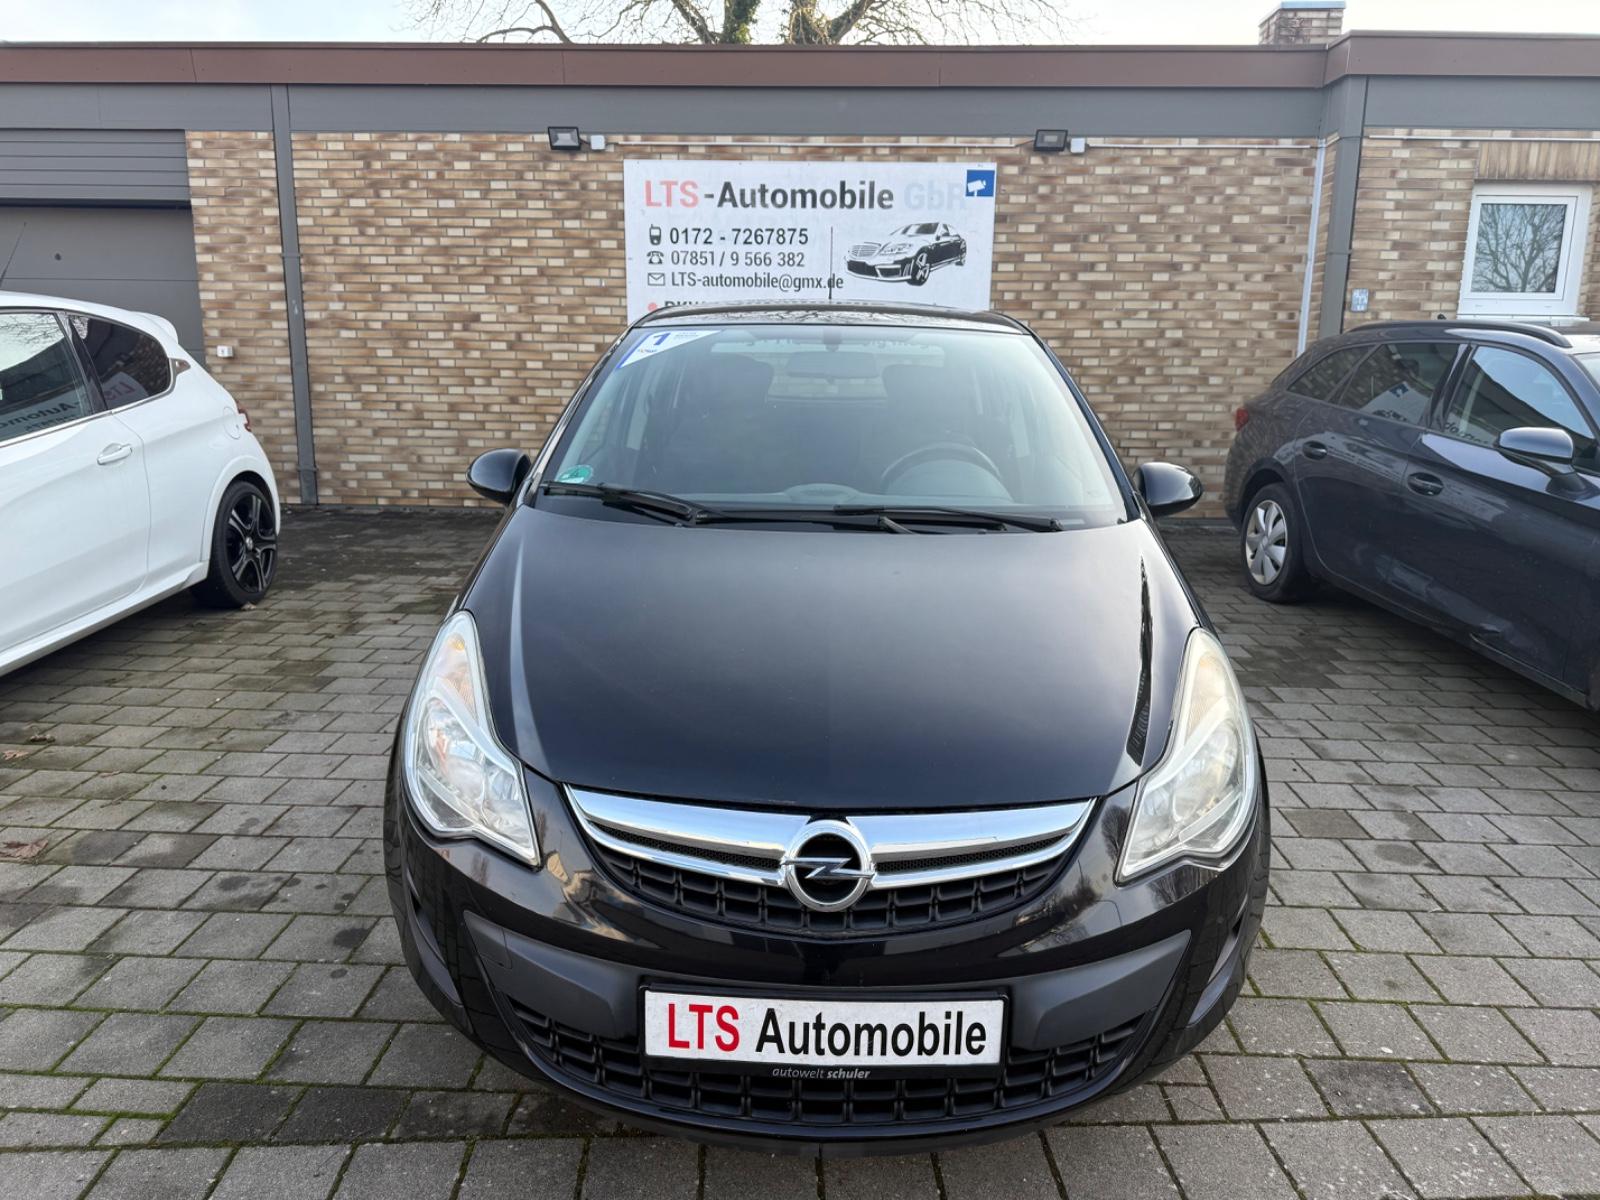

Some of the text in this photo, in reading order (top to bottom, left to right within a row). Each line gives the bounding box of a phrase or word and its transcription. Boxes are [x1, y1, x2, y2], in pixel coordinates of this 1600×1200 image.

[669, 227, 713, 245] 0172
[732, 228, 809, 245] 7267875
[671, 250, 715, 266] 07851
[730, 251, 739, 266] 9
[744, 252, 772, 267] 566
[777, 252, 805, 267] 382
[671, 272, 844, 292] LTS-automobile@gmx.de
[668, 1003, 987, 1056] LTS Automobile
[772, 1066, 871, 1079] autowelt schuler
